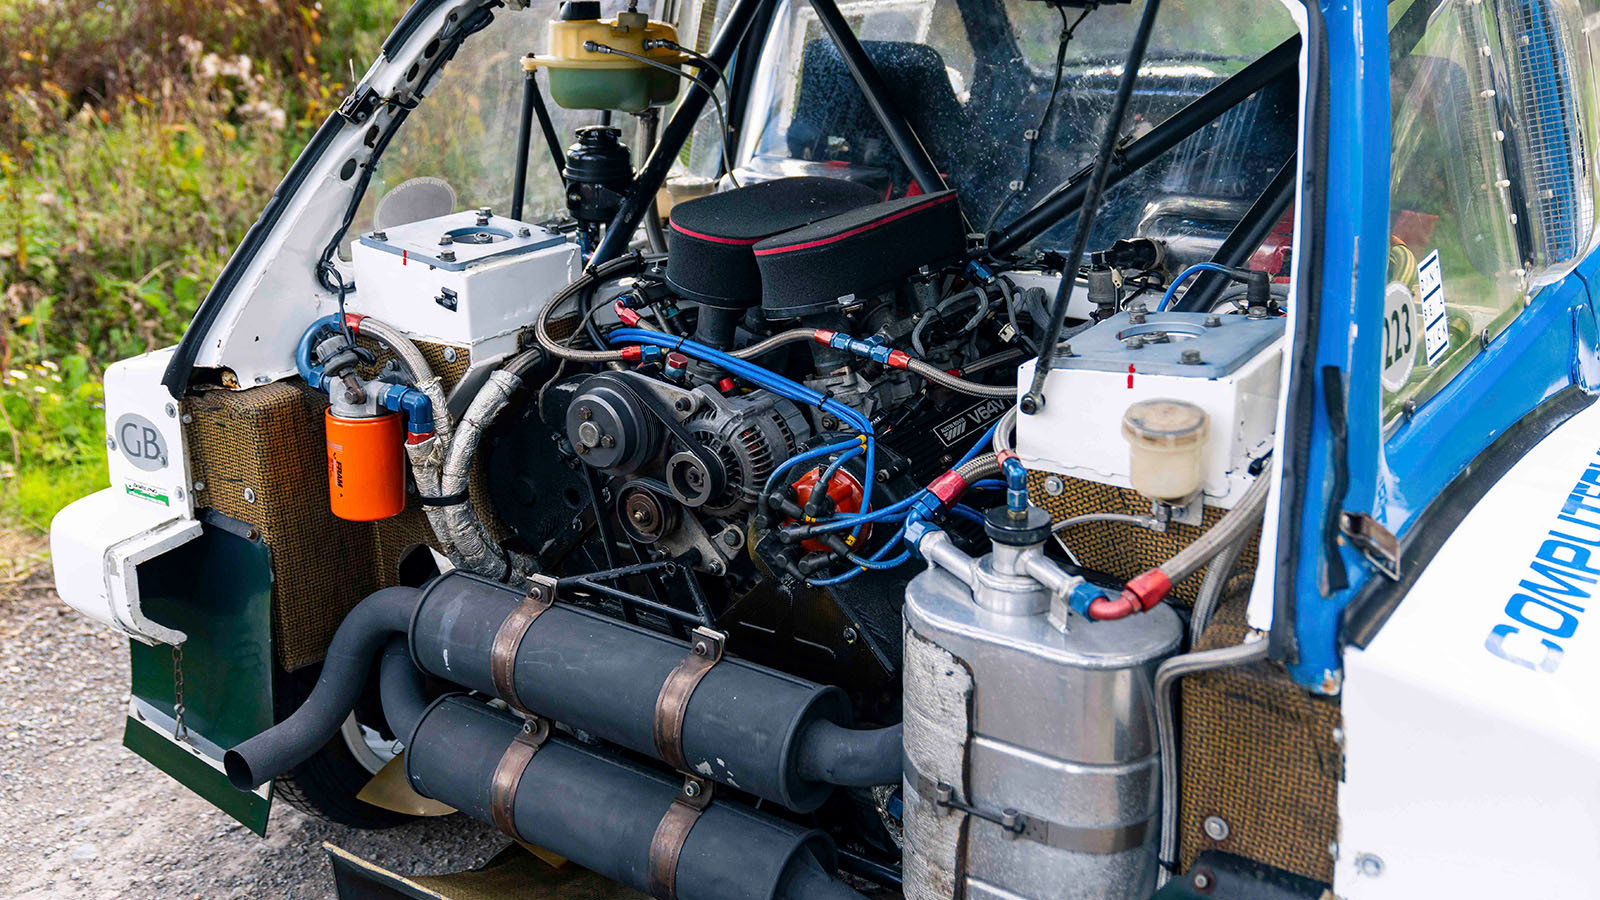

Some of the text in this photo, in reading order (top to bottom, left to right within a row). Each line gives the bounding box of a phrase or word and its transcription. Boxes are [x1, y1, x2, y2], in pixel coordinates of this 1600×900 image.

[967, 399, 1005, 424] V64V
[121, 422, 161, 460] GB
[335, 460, 344, 488] FRAM
[1484, 447, 1600, 674] COMPUT
